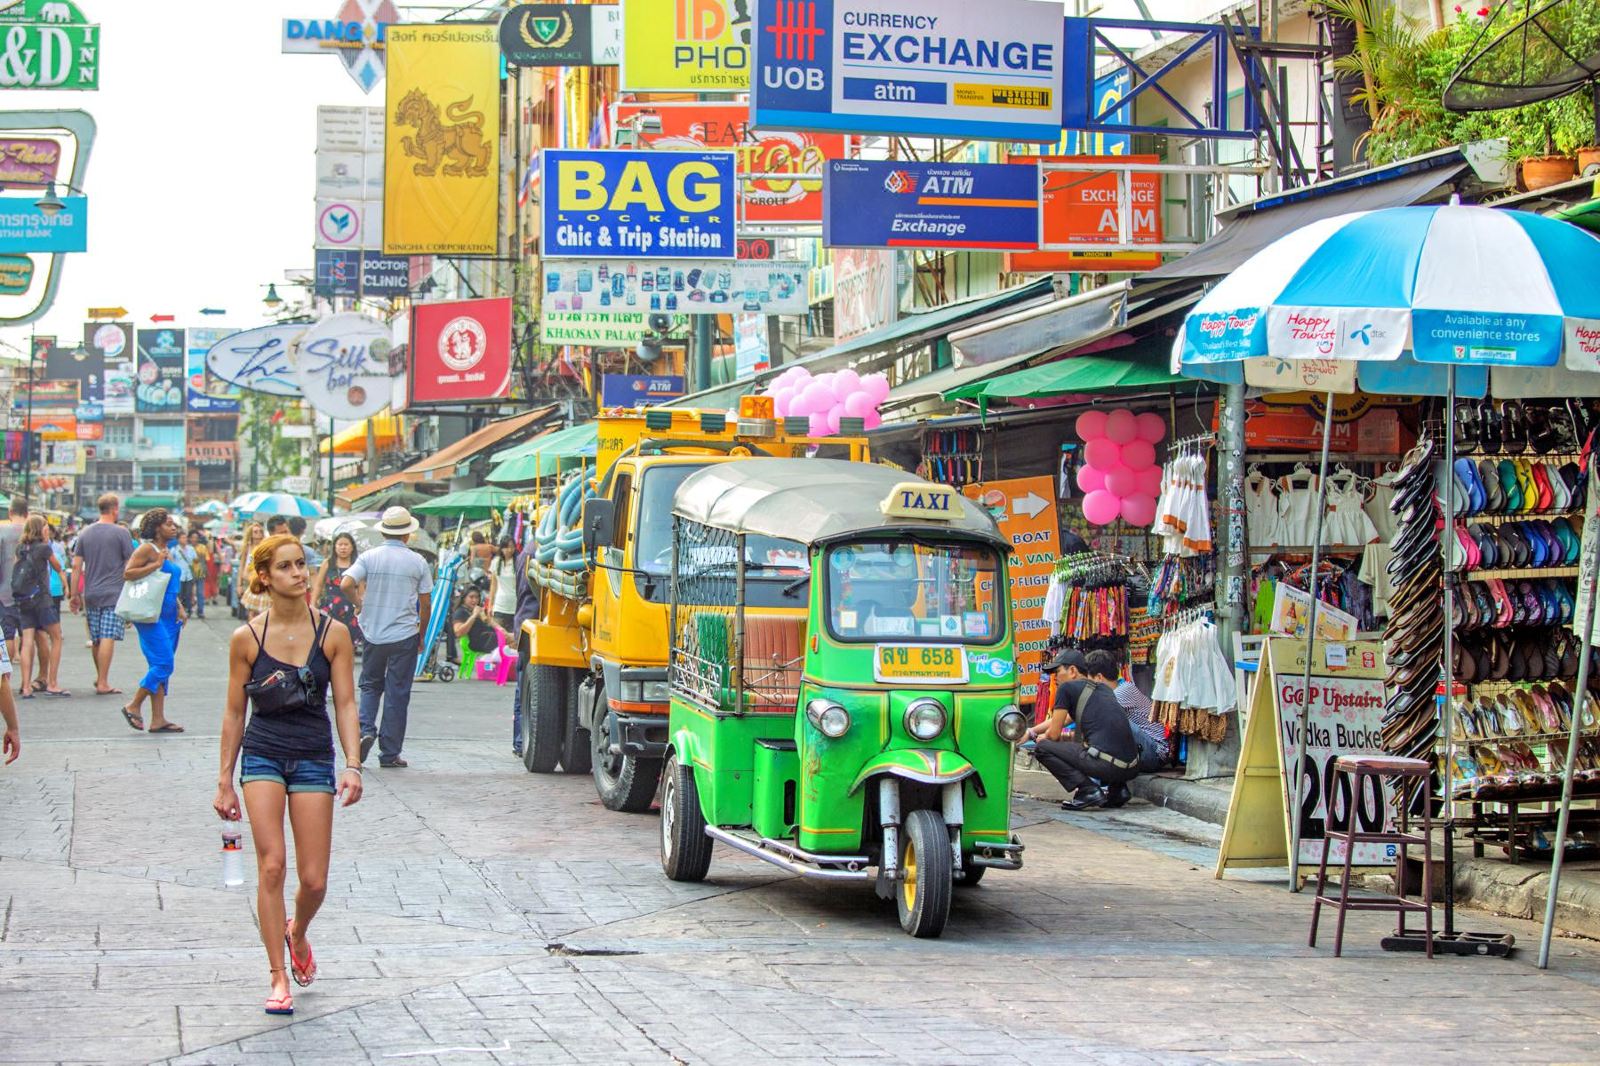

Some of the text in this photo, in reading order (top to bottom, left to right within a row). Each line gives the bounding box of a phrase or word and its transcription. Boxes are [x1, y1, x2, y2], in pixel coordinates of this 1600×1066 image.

[843, 11, 938, 29] CURRENCY
[287, 19, 363, 40] DANG
[79, 28, 96, 82] INN
[843, 31, 1054, 72] EXCHANGE
[764, 66, 825, 91] UOB
[874, 82, 916, 101] atm
[993, 89, 1040, 99] WESTERN
[1007, 97, 1040, 105] UNION
[558, 160, 721, 212] BAG
[922, 176, 975, 195] ATM
[1081, 189, 1155, 202] EXCHNGE
[558, 214, 721, 224] LOCKER
[892, 218, 966, 236] Exchange
[1097, 208, 1156, 233] AM
[387, 243, 495, 251] SINGHA CORPORATION
[556, 224, 721, 252] Chic & Trip Station
[363, 259, 408, 270] DOCTOR
[1287, 313, 1331, 333] Happy
[1444, 314, 1527, 330] Available at any
[546, 327, 600, 340] KHAOSAN
[1291, 327, 1336, 340] Tourist
[1431, 327, 1540, 342] convenience stores
[231, 338, 297, 382] The
[305, 338, 367, 374] Silk
[1475, 350, 1512, 360] FamilyMart
[648, 383, 672, 391] ATM
[901, 490, 951, 511] TAXI
[1012, 531, 1051, 544] BOAT
[1026, 552, 1054, 564] VAN
[921, 648, 955, 665] 658
[1323, 687, 1384, 713] Upstairs
